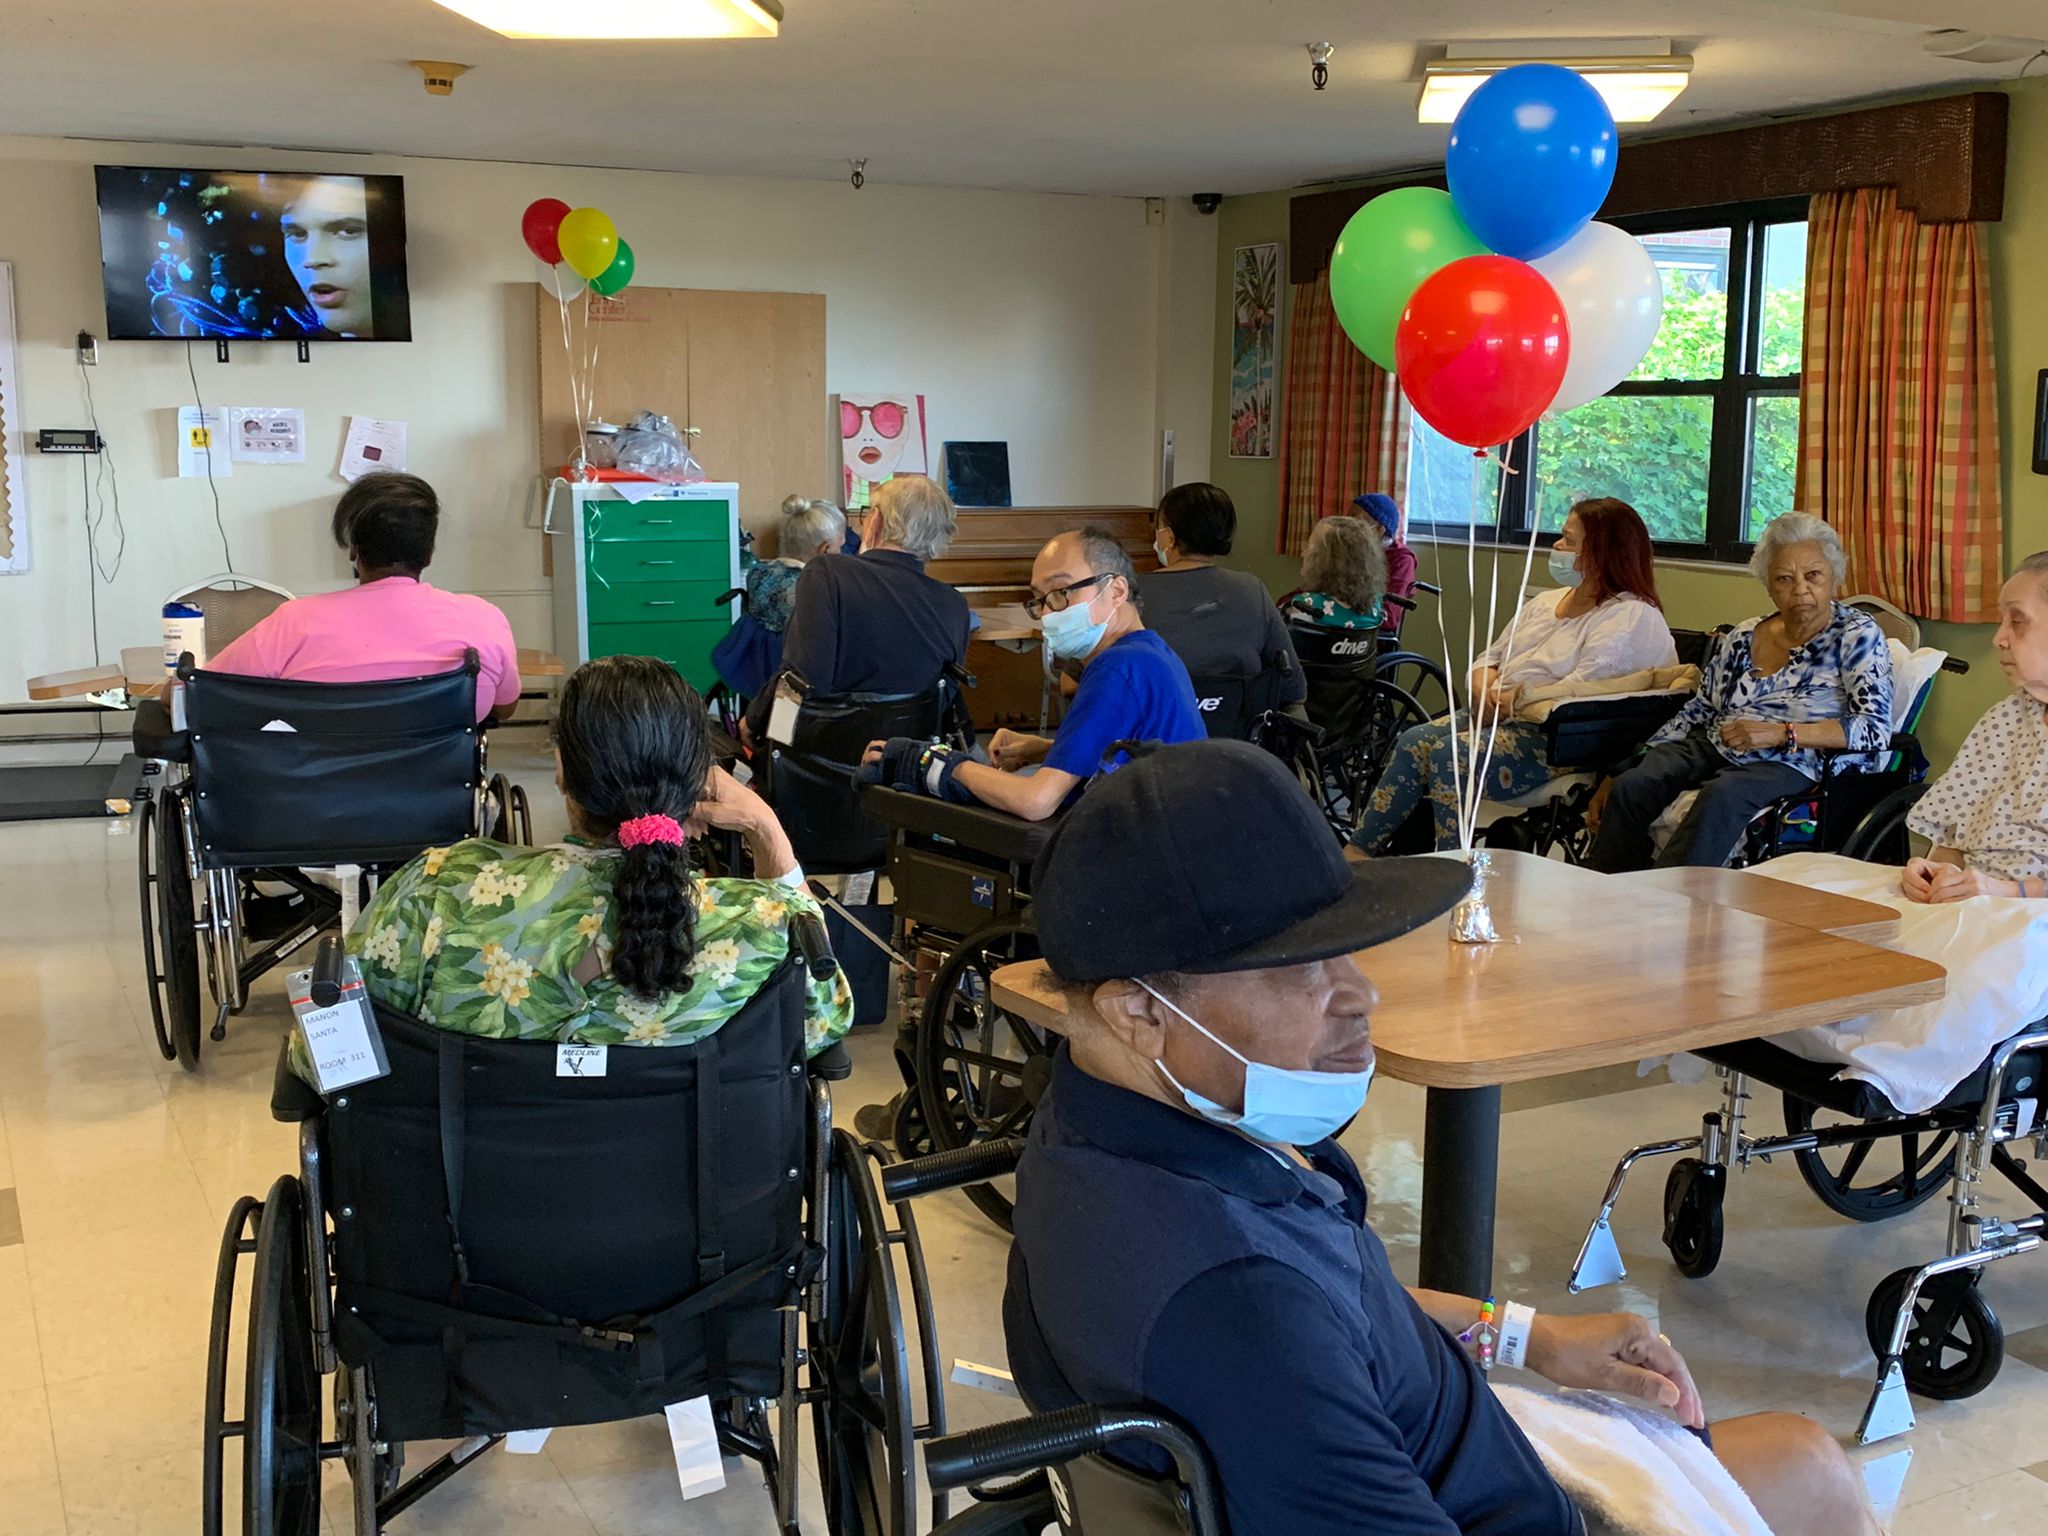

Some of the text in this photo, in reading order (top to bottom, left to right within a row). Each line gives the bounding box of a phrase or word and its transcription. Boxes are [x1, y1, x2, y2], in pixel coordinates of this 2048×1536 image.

[1331, 638, 1369, 655] drive
[310, 1027, 338, 1041] SANTA
[320, 1051, 366, 1071] ROOM 311
